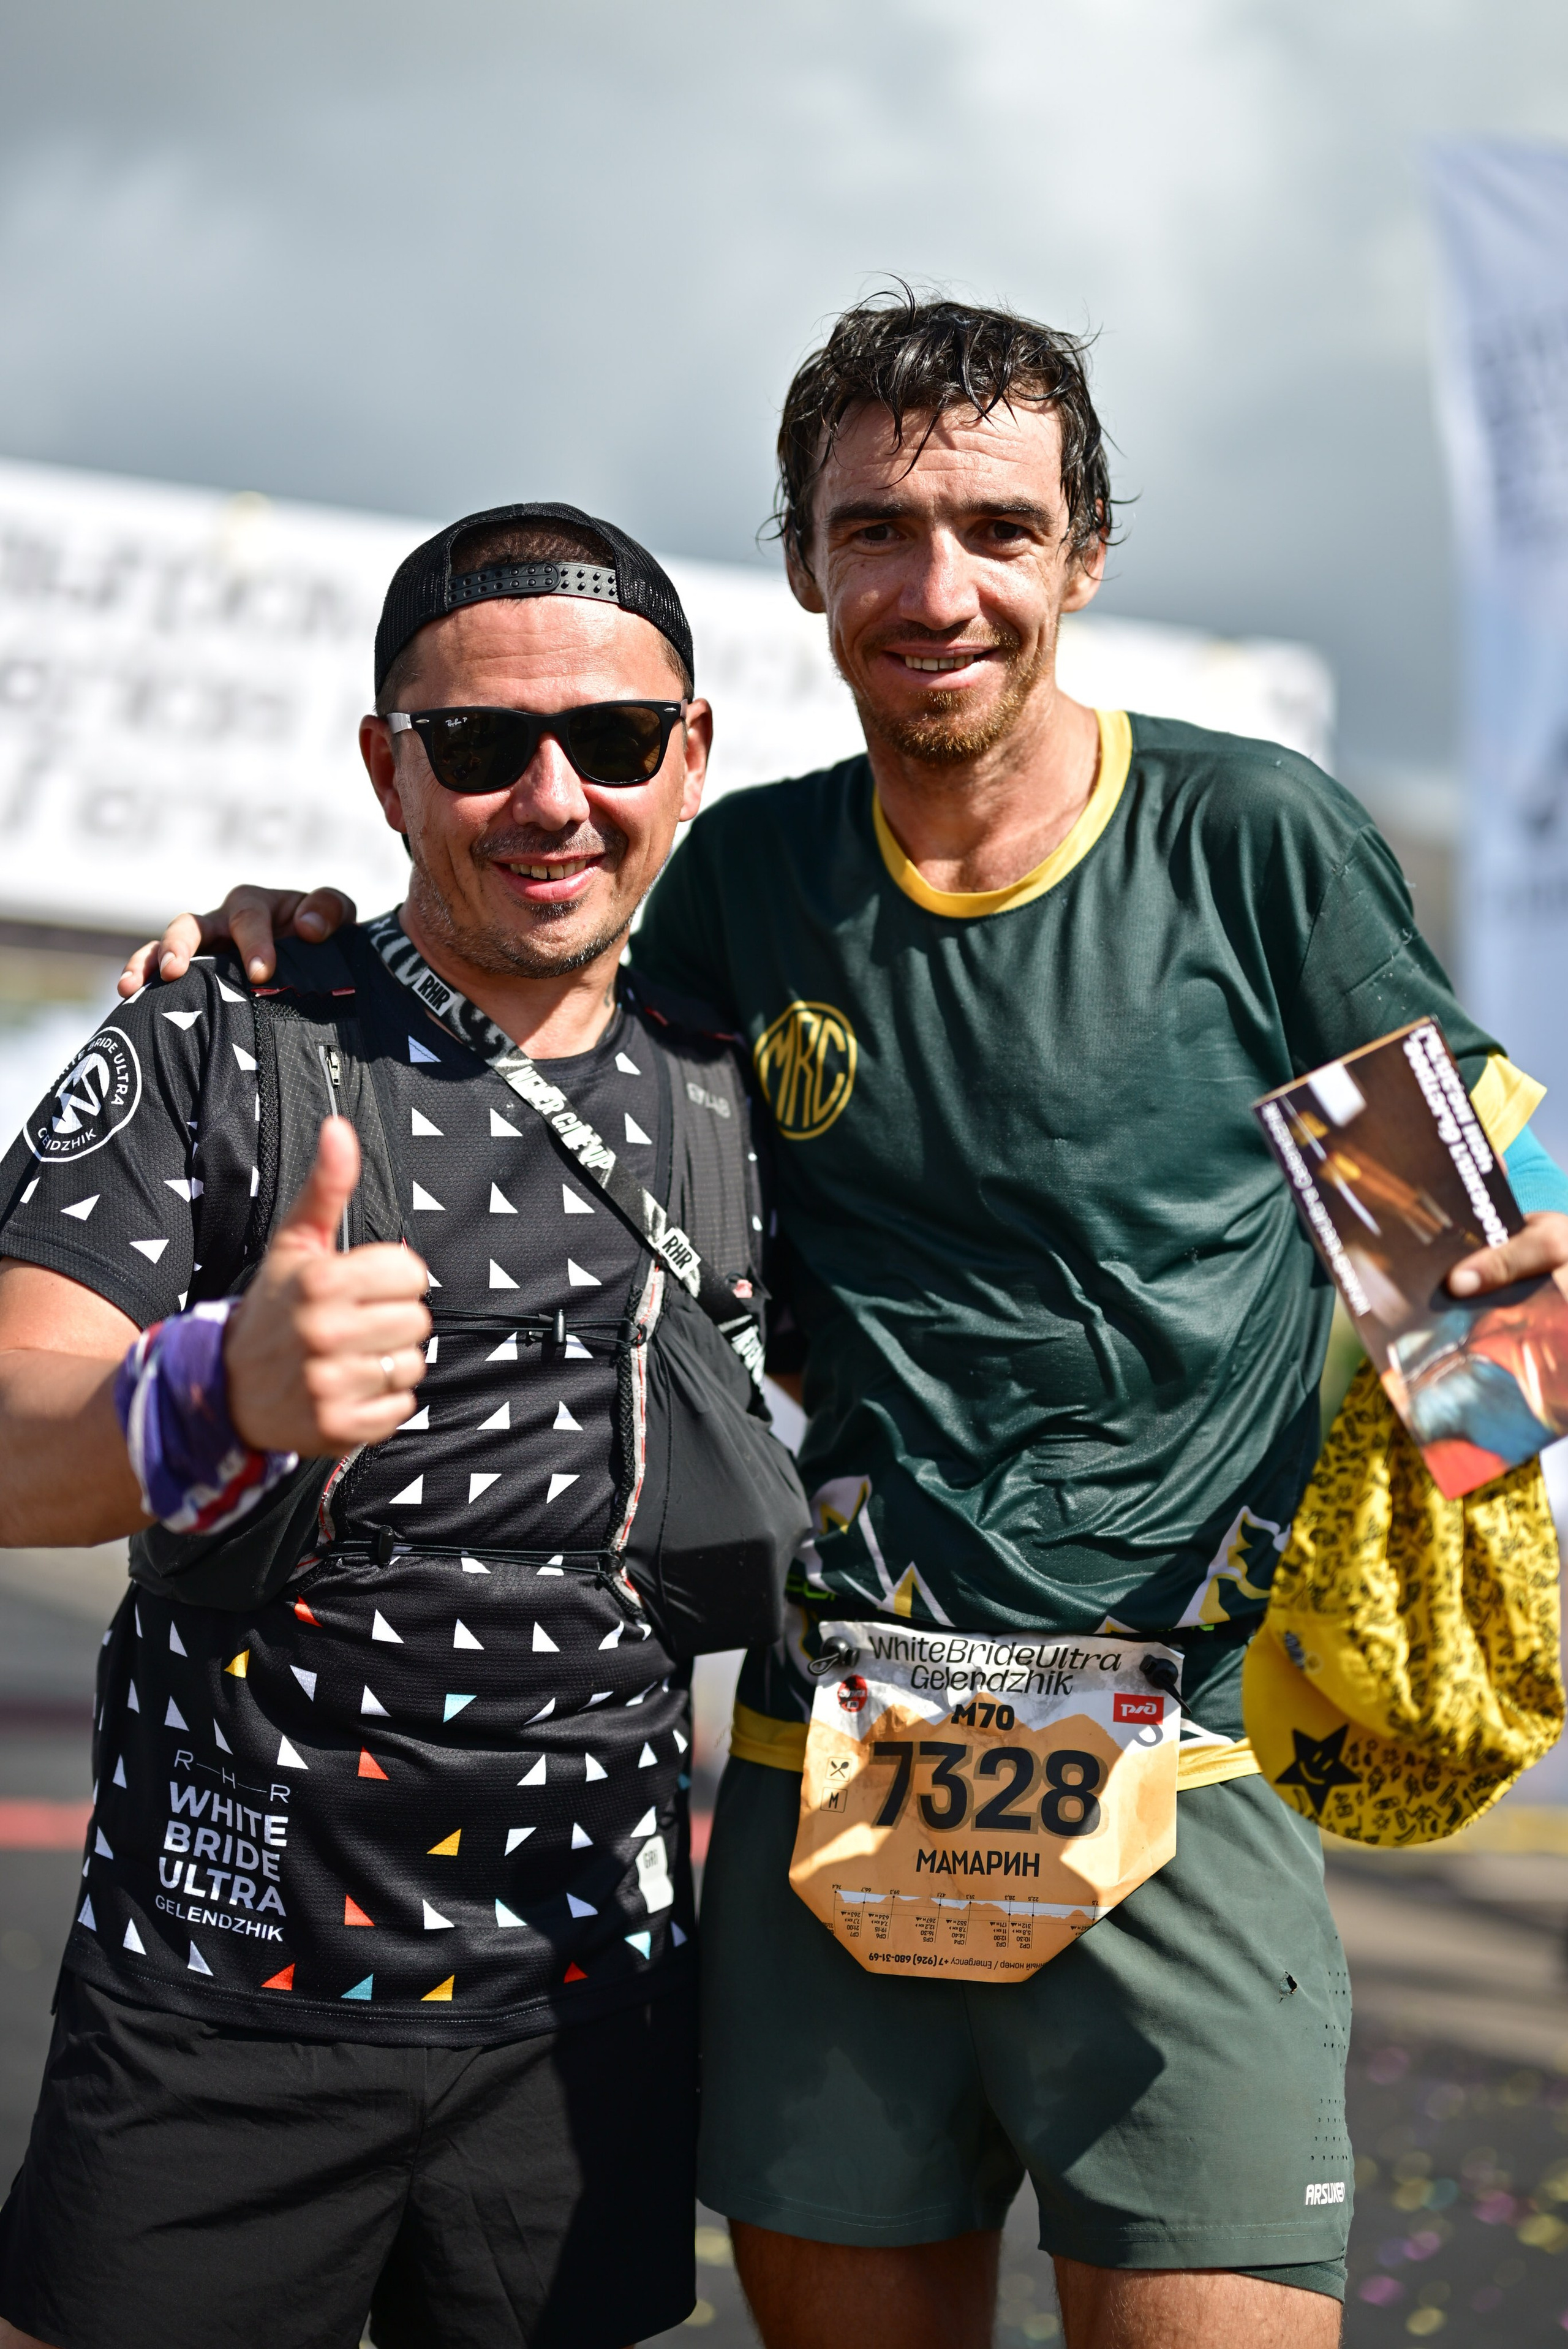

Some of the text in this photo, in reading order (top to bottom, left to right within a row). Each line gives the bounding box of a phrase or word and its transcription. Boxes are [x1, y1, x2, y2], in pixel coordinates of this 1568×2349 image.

[417, 974, 450, 1010] RHR
[111, 1053, 129, 1105] ULTRA
[662, 1235, 693, 1270] RHR
[869, 1636, 1122, 1672] WhiteBrideUltra
[911, 1665, 1073, 1696] Gelendzhik
[873, 1741, 1104, 1837] 7328
[170, 1781, 288, 1847] WHITE
[164, 1820, 281, 1882] BRIDE
[916, 1848, 1040, 1877] МАМАРИН
[159, 1856, 287, 1916] ULTRA
[156, 1894, 284, 1942] GELENDZHIK
[869, 1953, 911, 1963] 680-31-69
[913, 1954, 937, 1967] (926)
[951, 1956, 992, 1969] Emergency
[1000, 1960, 1024, 1970] номер
